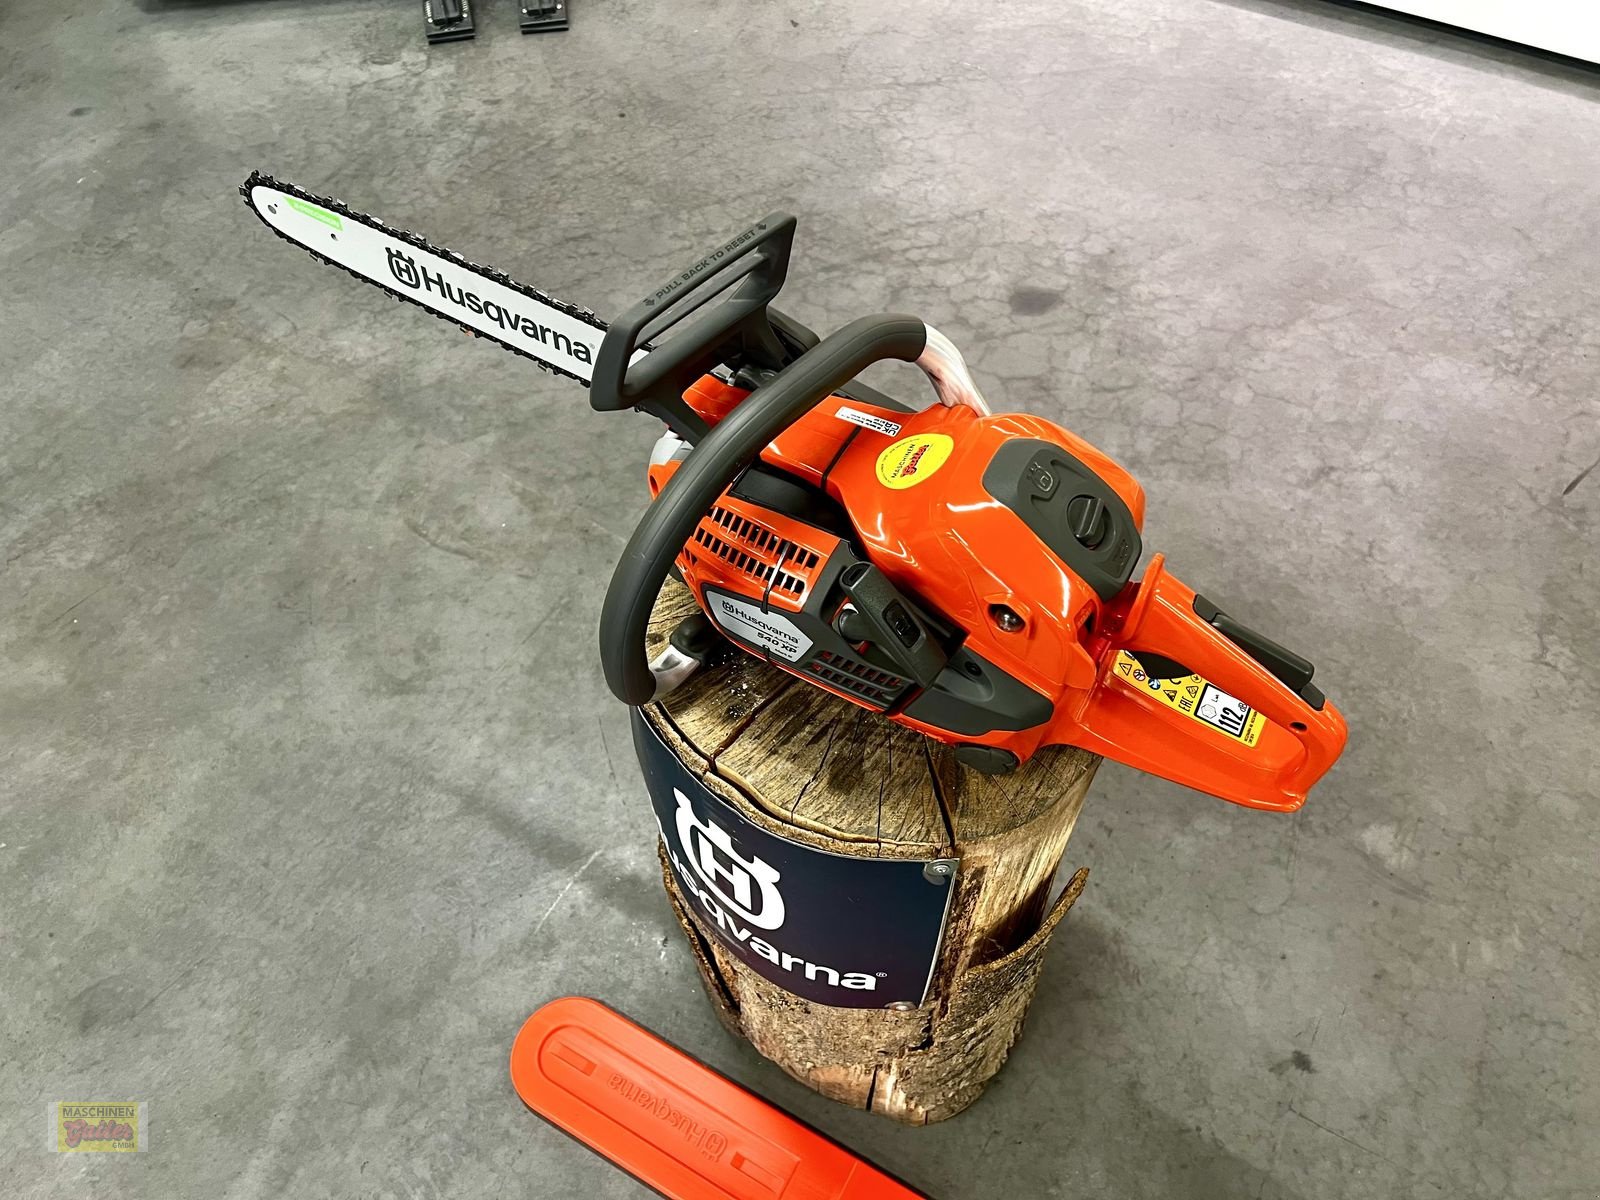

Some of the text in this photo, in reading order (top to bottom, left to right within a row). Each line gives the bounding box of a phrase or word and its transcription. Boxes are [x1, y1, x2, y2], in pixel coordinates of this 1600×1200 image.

[655, 229, 756, 300] PULL BACK TO RESET
[420, 265, 593, 366] Husqvarna
[881, 426, 897, 436] UK
[884, 421, 900, 431] CA
[891, 443, 916, 479] MASCHINEN
[735, 607, 799, 644] Husqvarna
[757, 632, 797, 654] 540 XP
[1218, 707, 1244, 731] 112
[656, 815, 878, 991] usqvarna
[608, 1073, 707, 1148] Husqvarna
